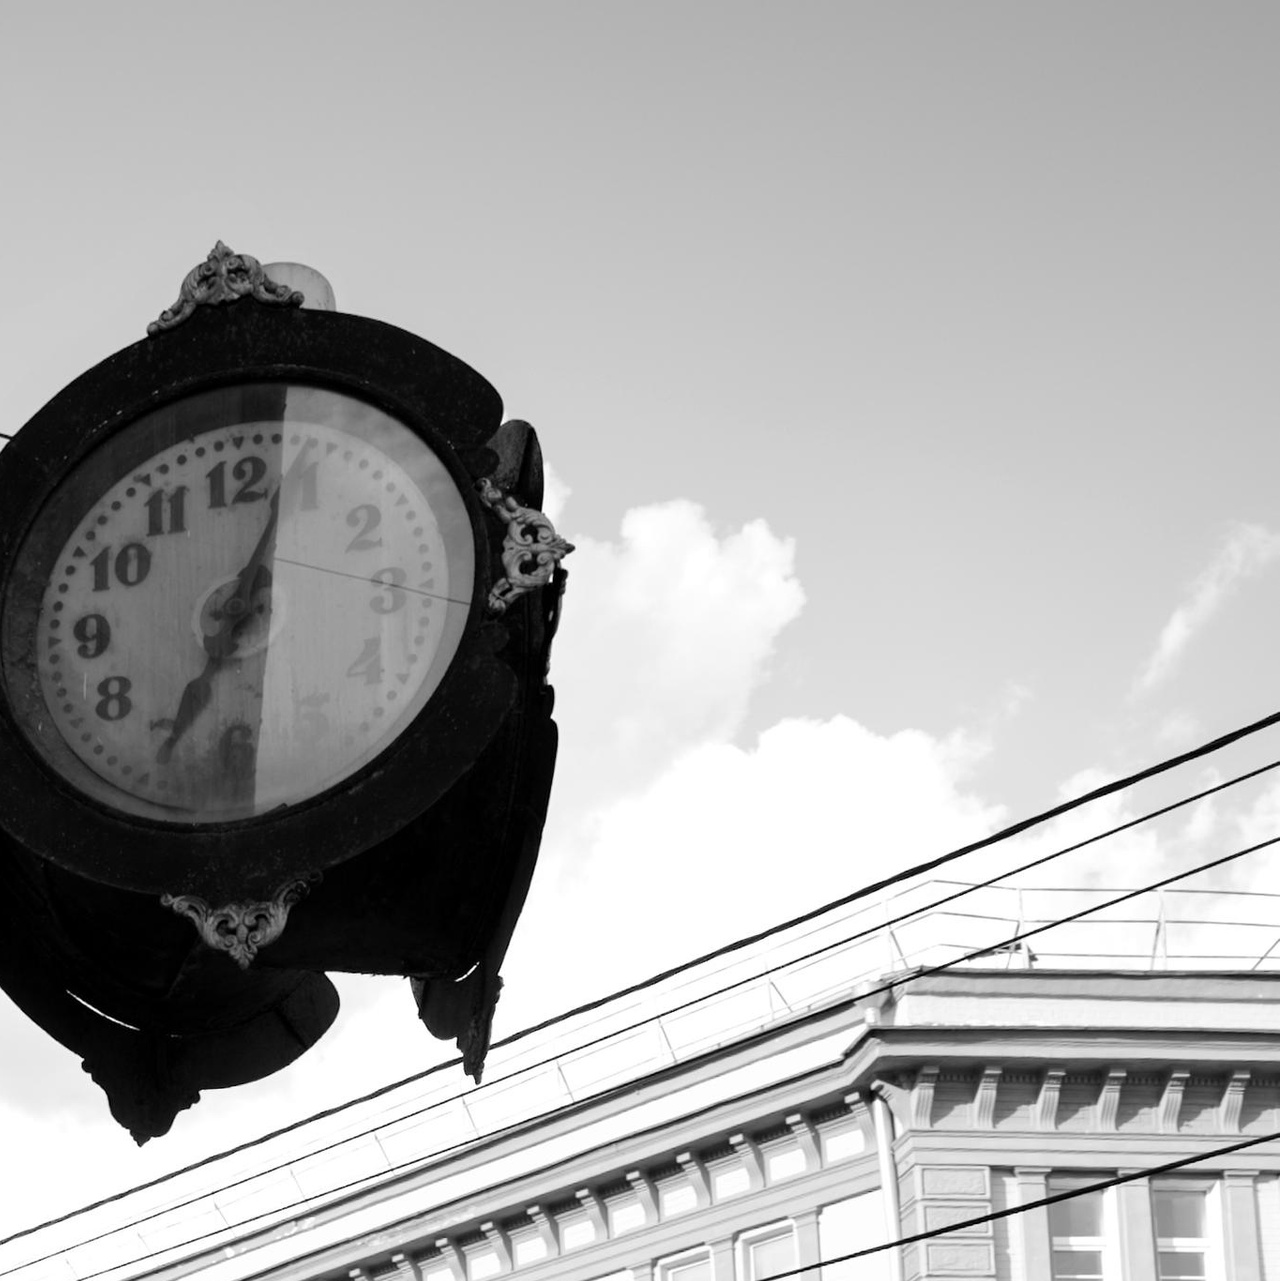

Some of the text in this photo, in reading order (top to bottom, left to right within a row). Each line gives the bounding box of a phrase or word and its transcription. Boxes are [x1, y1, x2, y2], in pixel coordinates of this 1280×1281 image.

[205, 456, 268, 509] 12
[297, 461, 320, 512] 1
[144, 485, 190, 537] 11
[344, 504, 383, 553] 2
[90, 542, 151, 593] 10
[369, 567, 408, 615] 3
[73, 613, 111, 660] 9
[347, 637, 386, 686] 4
[95, 675, 132, 722] 8
